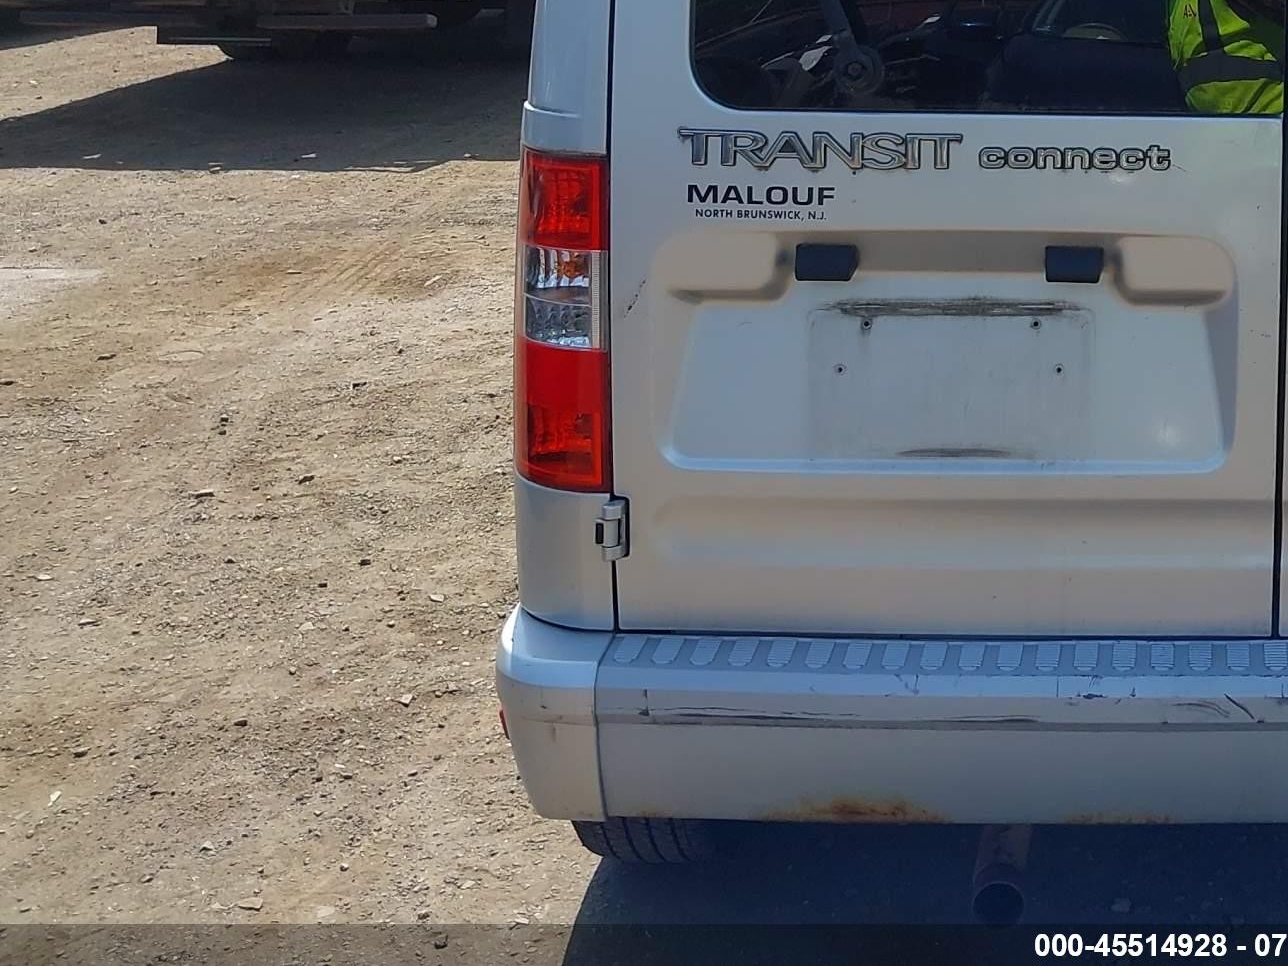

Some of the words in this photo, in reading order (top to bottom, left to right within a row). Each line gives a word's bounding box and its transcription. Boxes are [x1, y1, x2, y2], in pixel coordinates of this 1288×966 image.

[677, 127, 963, 170] TRANSIT
[978, 144, 1172, 171] connect
[687, 184, 836, 206] MALOUF
[695, 208, 734, 219] NORTH
[736, 209, 805, 222] BRUNSWICK,
[807, 210, 828, 221] N.J.
